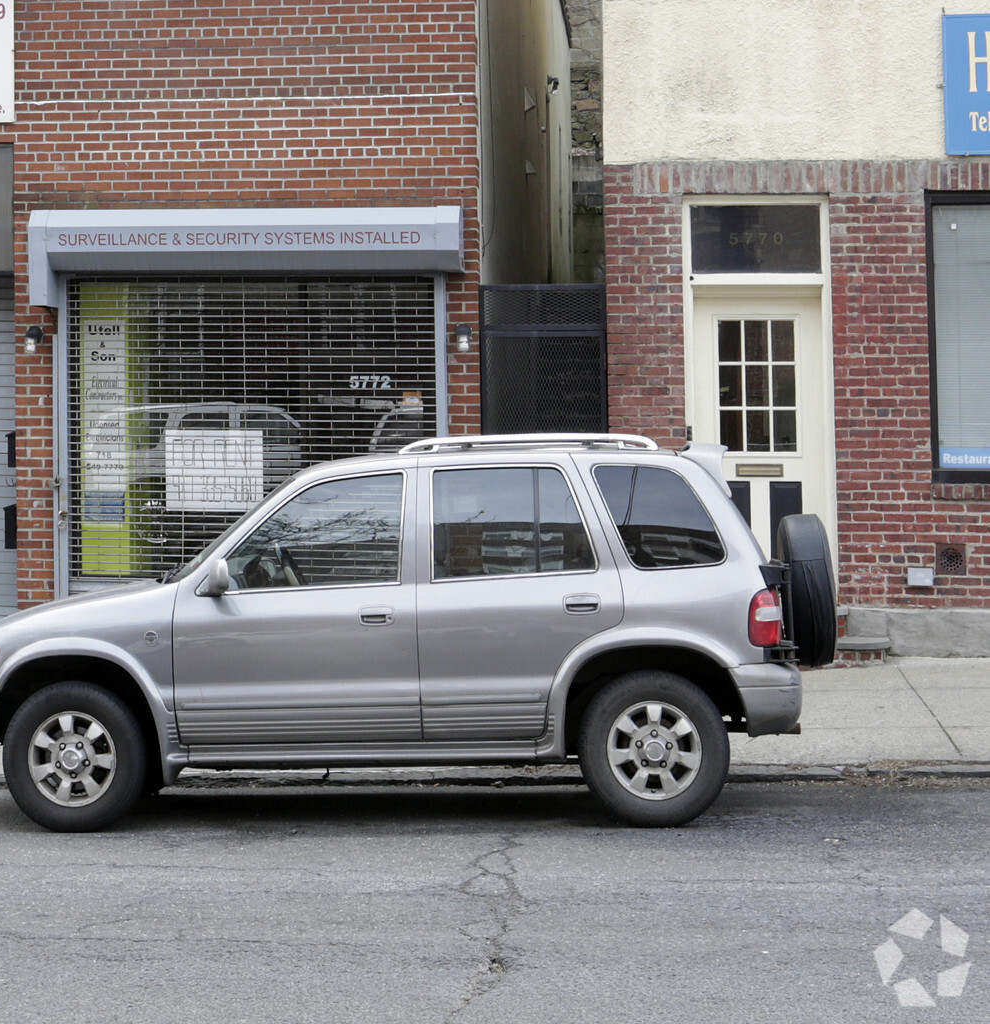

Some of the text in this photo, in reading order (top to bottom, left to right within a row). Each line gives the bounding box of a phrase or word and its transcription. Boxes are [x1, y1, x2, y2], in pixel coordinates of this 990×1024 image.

[58, 231, 421, 246] SURVEILLANCE & SECURITY SYSTEMS INSTALLED
[729, 232, 784, 246] 5770
[88, 324, 120, 336] Utell
[91, 351, 116, 361] Son
[350, 375, 391, 389] 5772
[96, 451, 112, 459] 718
